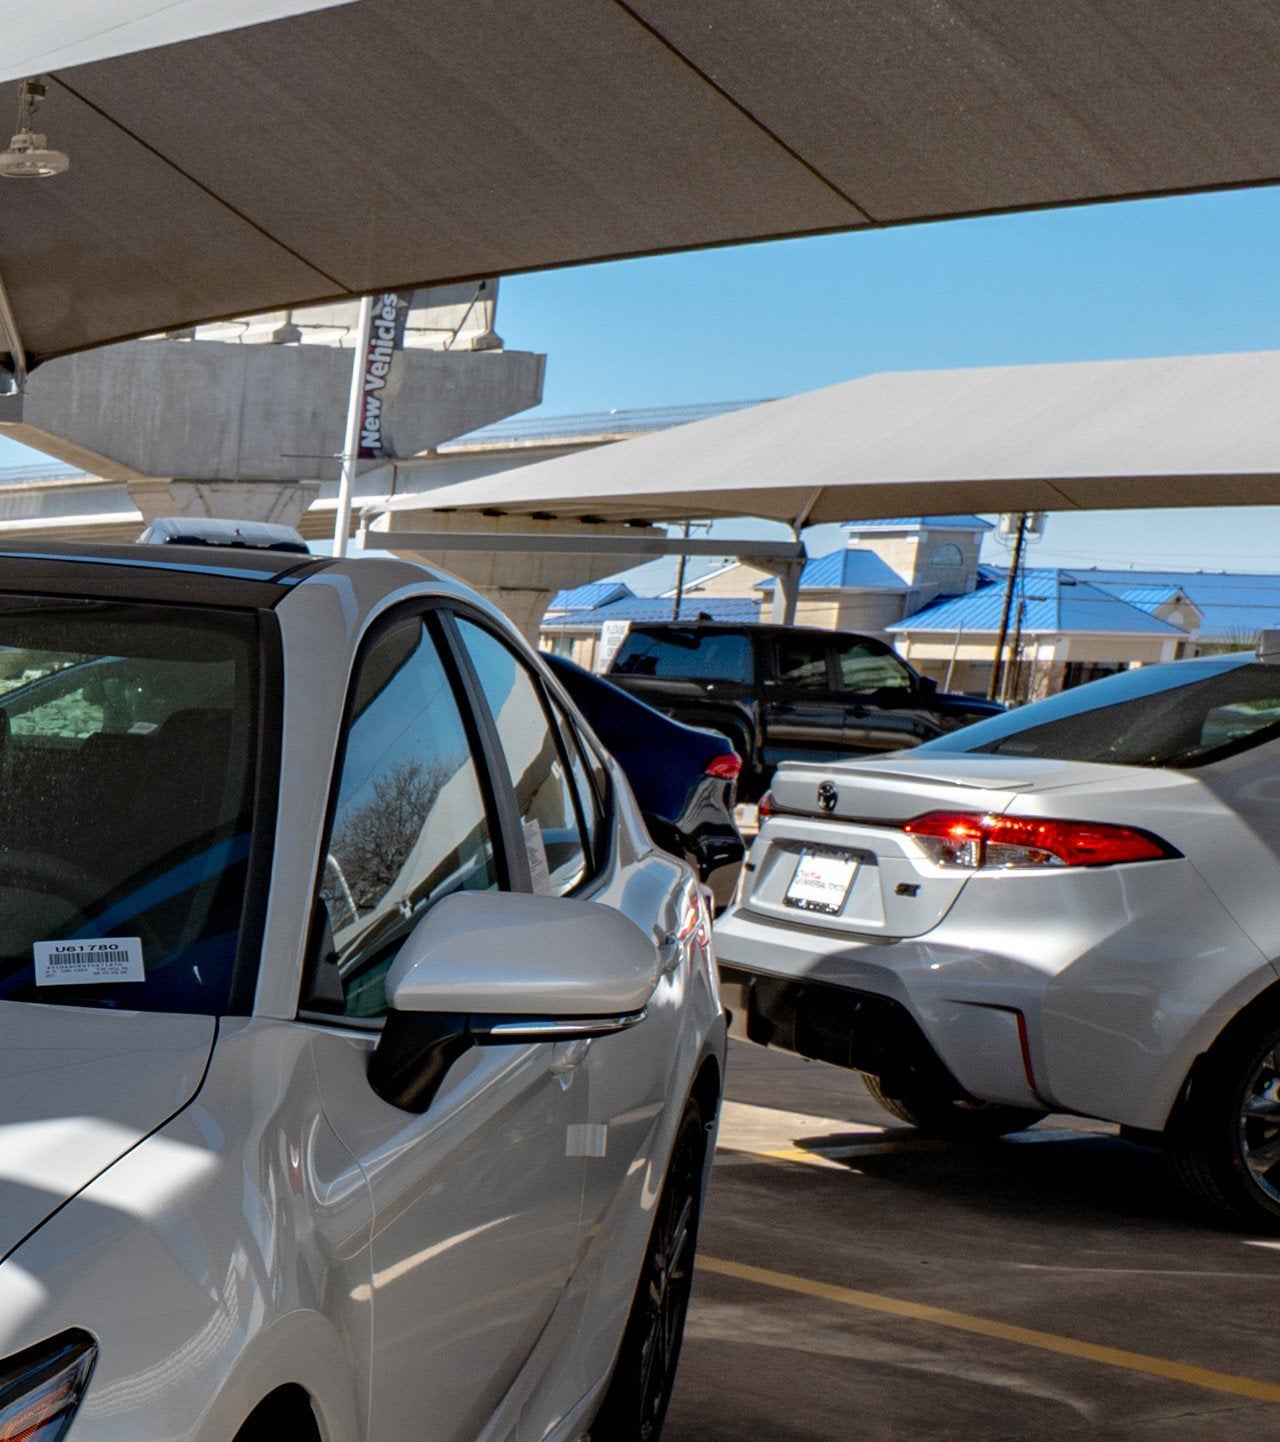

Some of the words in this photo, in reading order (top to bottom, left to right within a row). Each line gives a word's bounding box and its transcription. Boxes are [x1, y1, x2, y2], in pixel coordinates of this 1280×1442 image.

[364, 292, 398, 391] Vehicles
[360, 396, 382, 449] New
[54, 943, 120, 953] U61780
